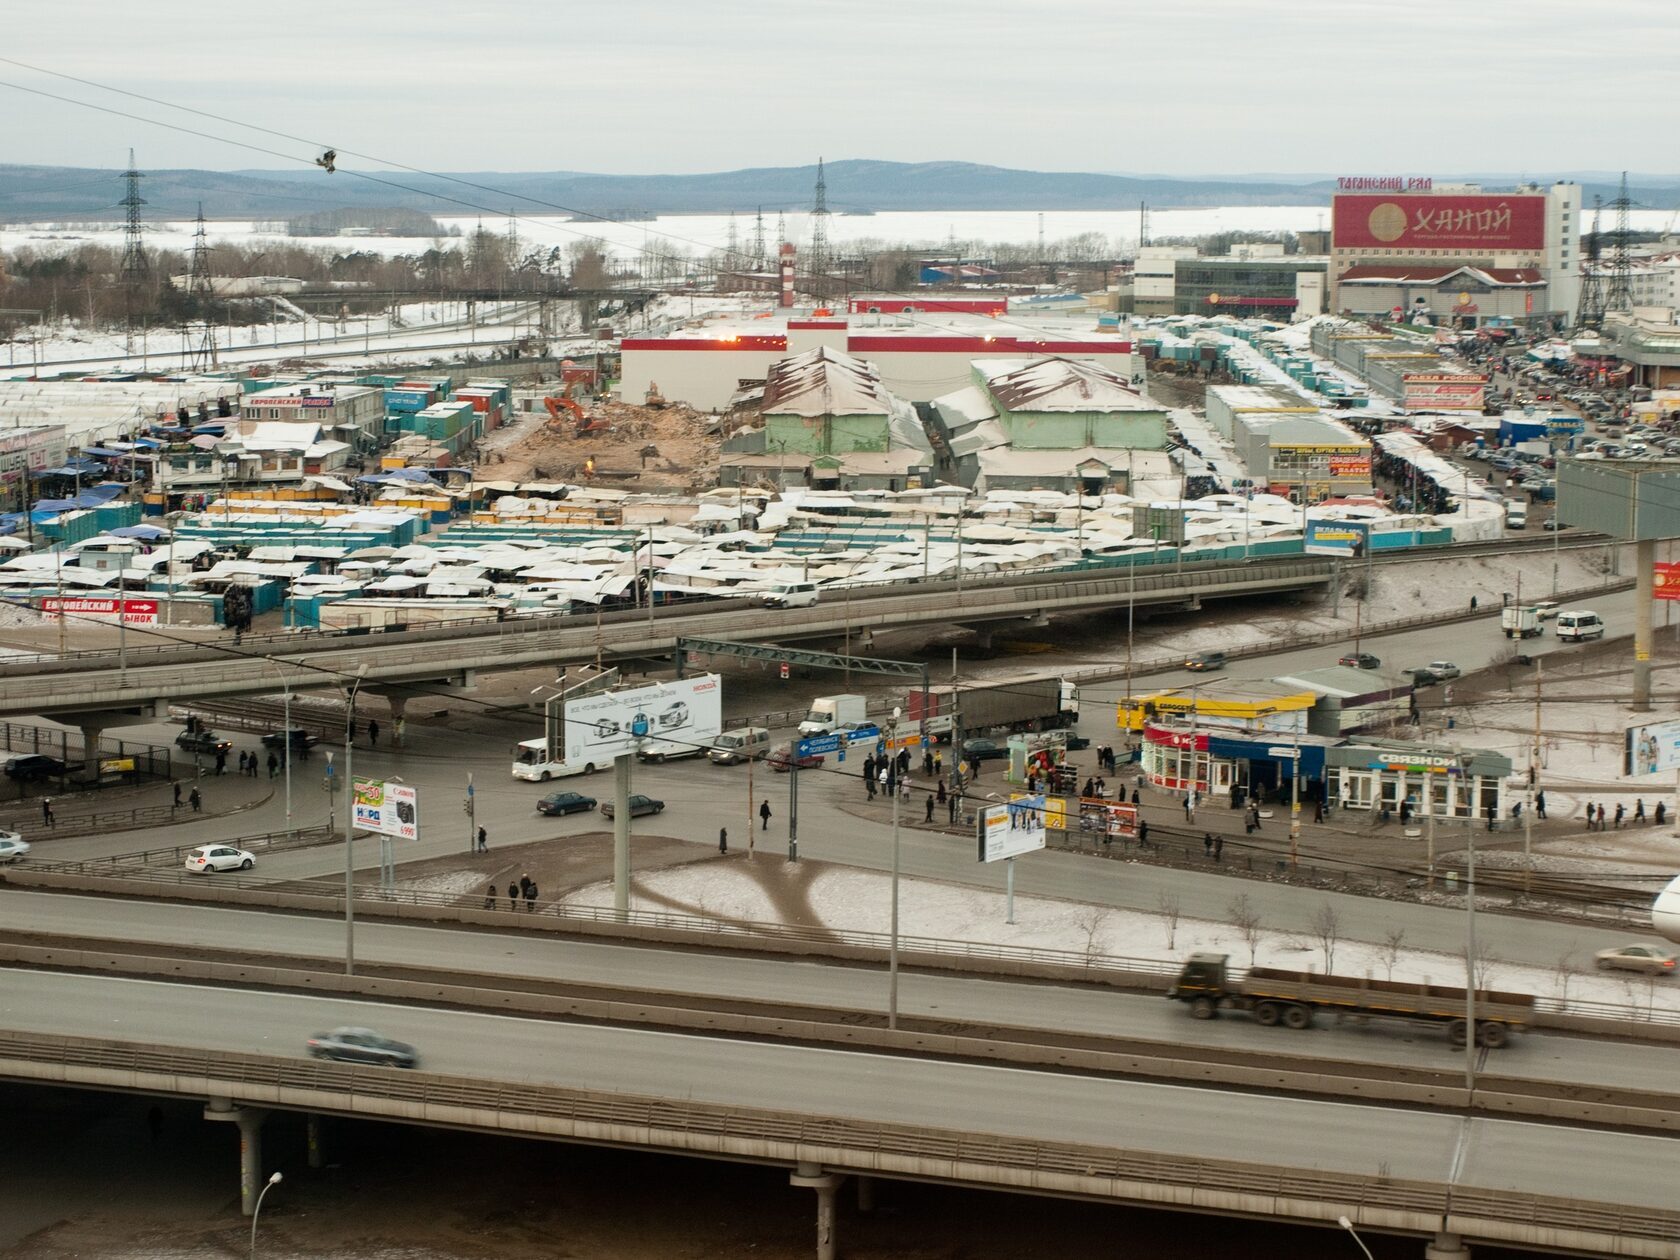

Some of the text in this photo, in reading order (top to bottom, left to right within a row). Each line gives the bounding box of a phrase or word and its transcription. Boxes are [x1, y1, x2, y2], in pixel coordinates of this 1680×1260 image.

[1338, 176, 1432, 190] ТАГАНСКИЙ РЯД
[1412, 202, 1512, 232] ХАНОЙ
[30, 448, 47, 465] ТУТ
[121, 613, 153, 623] ЫНОК
[693, 682, 717, 692] HONDA
[393, 787, 415, 798] Canon
